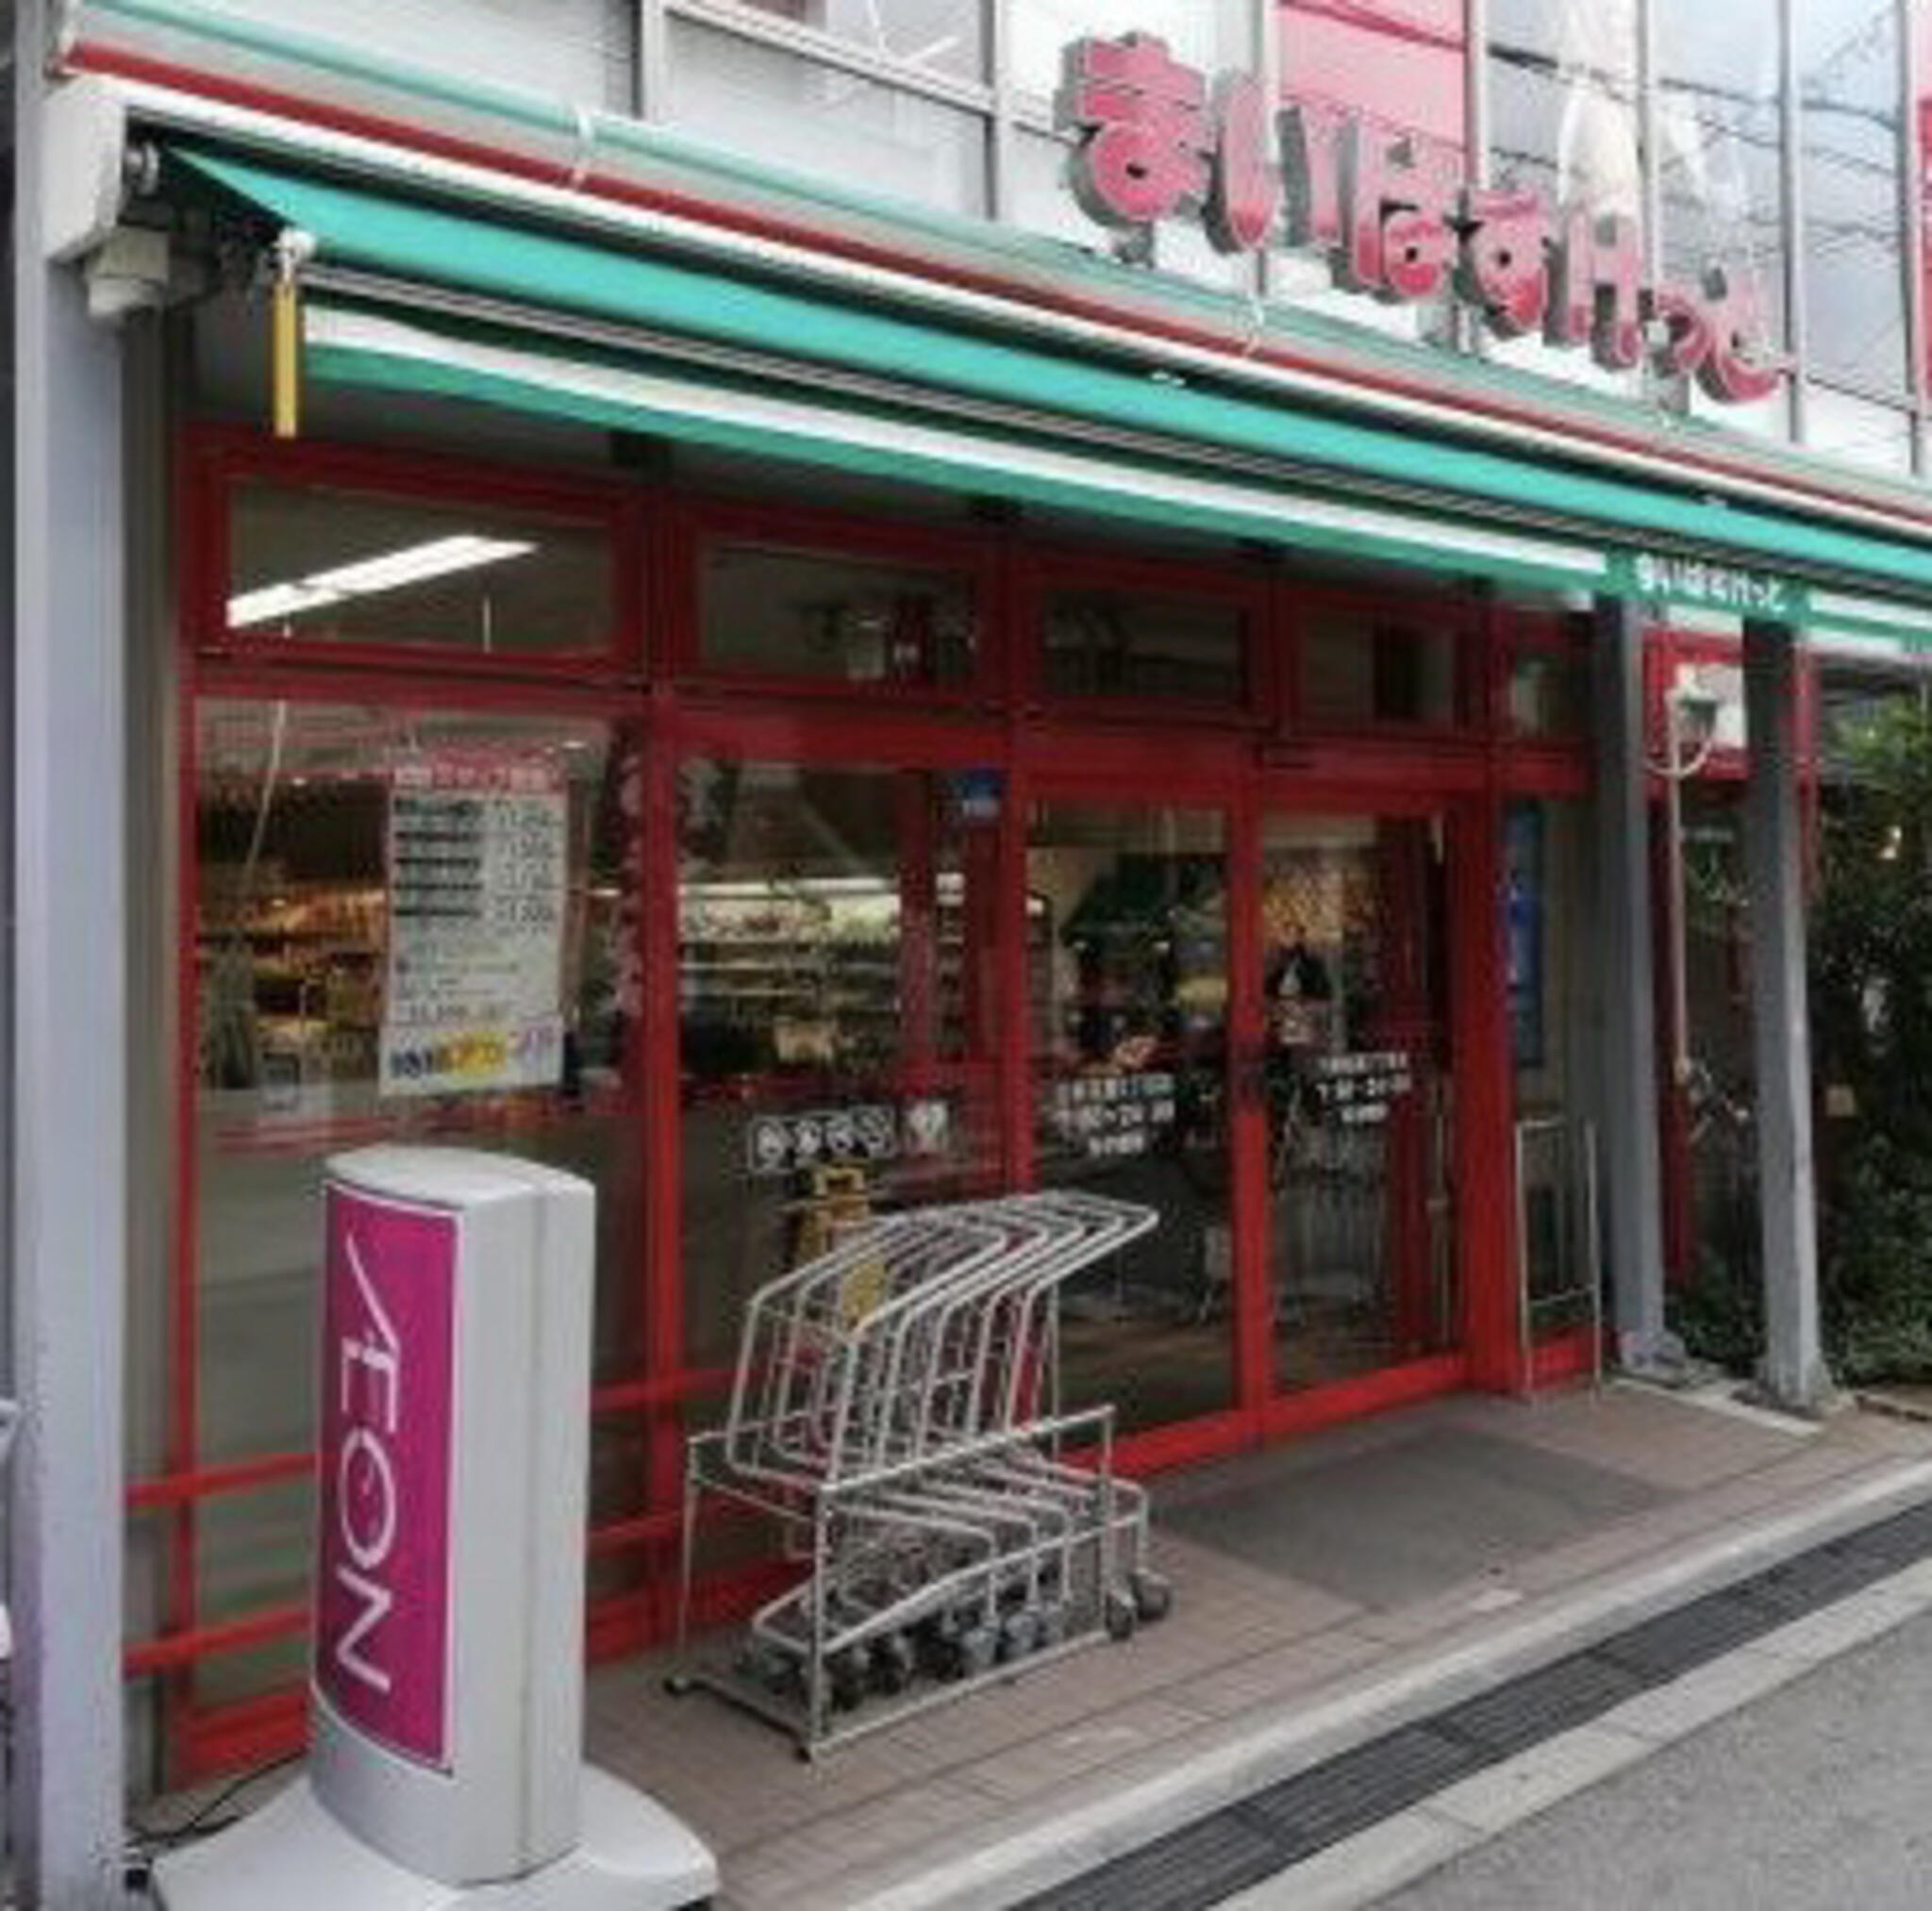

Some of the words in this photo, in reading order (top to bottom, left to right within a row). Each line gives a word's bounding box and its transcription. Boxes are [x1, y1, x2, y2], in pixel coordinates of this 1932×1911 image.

[1057, 34, 1794, 403] まいばすけっと
